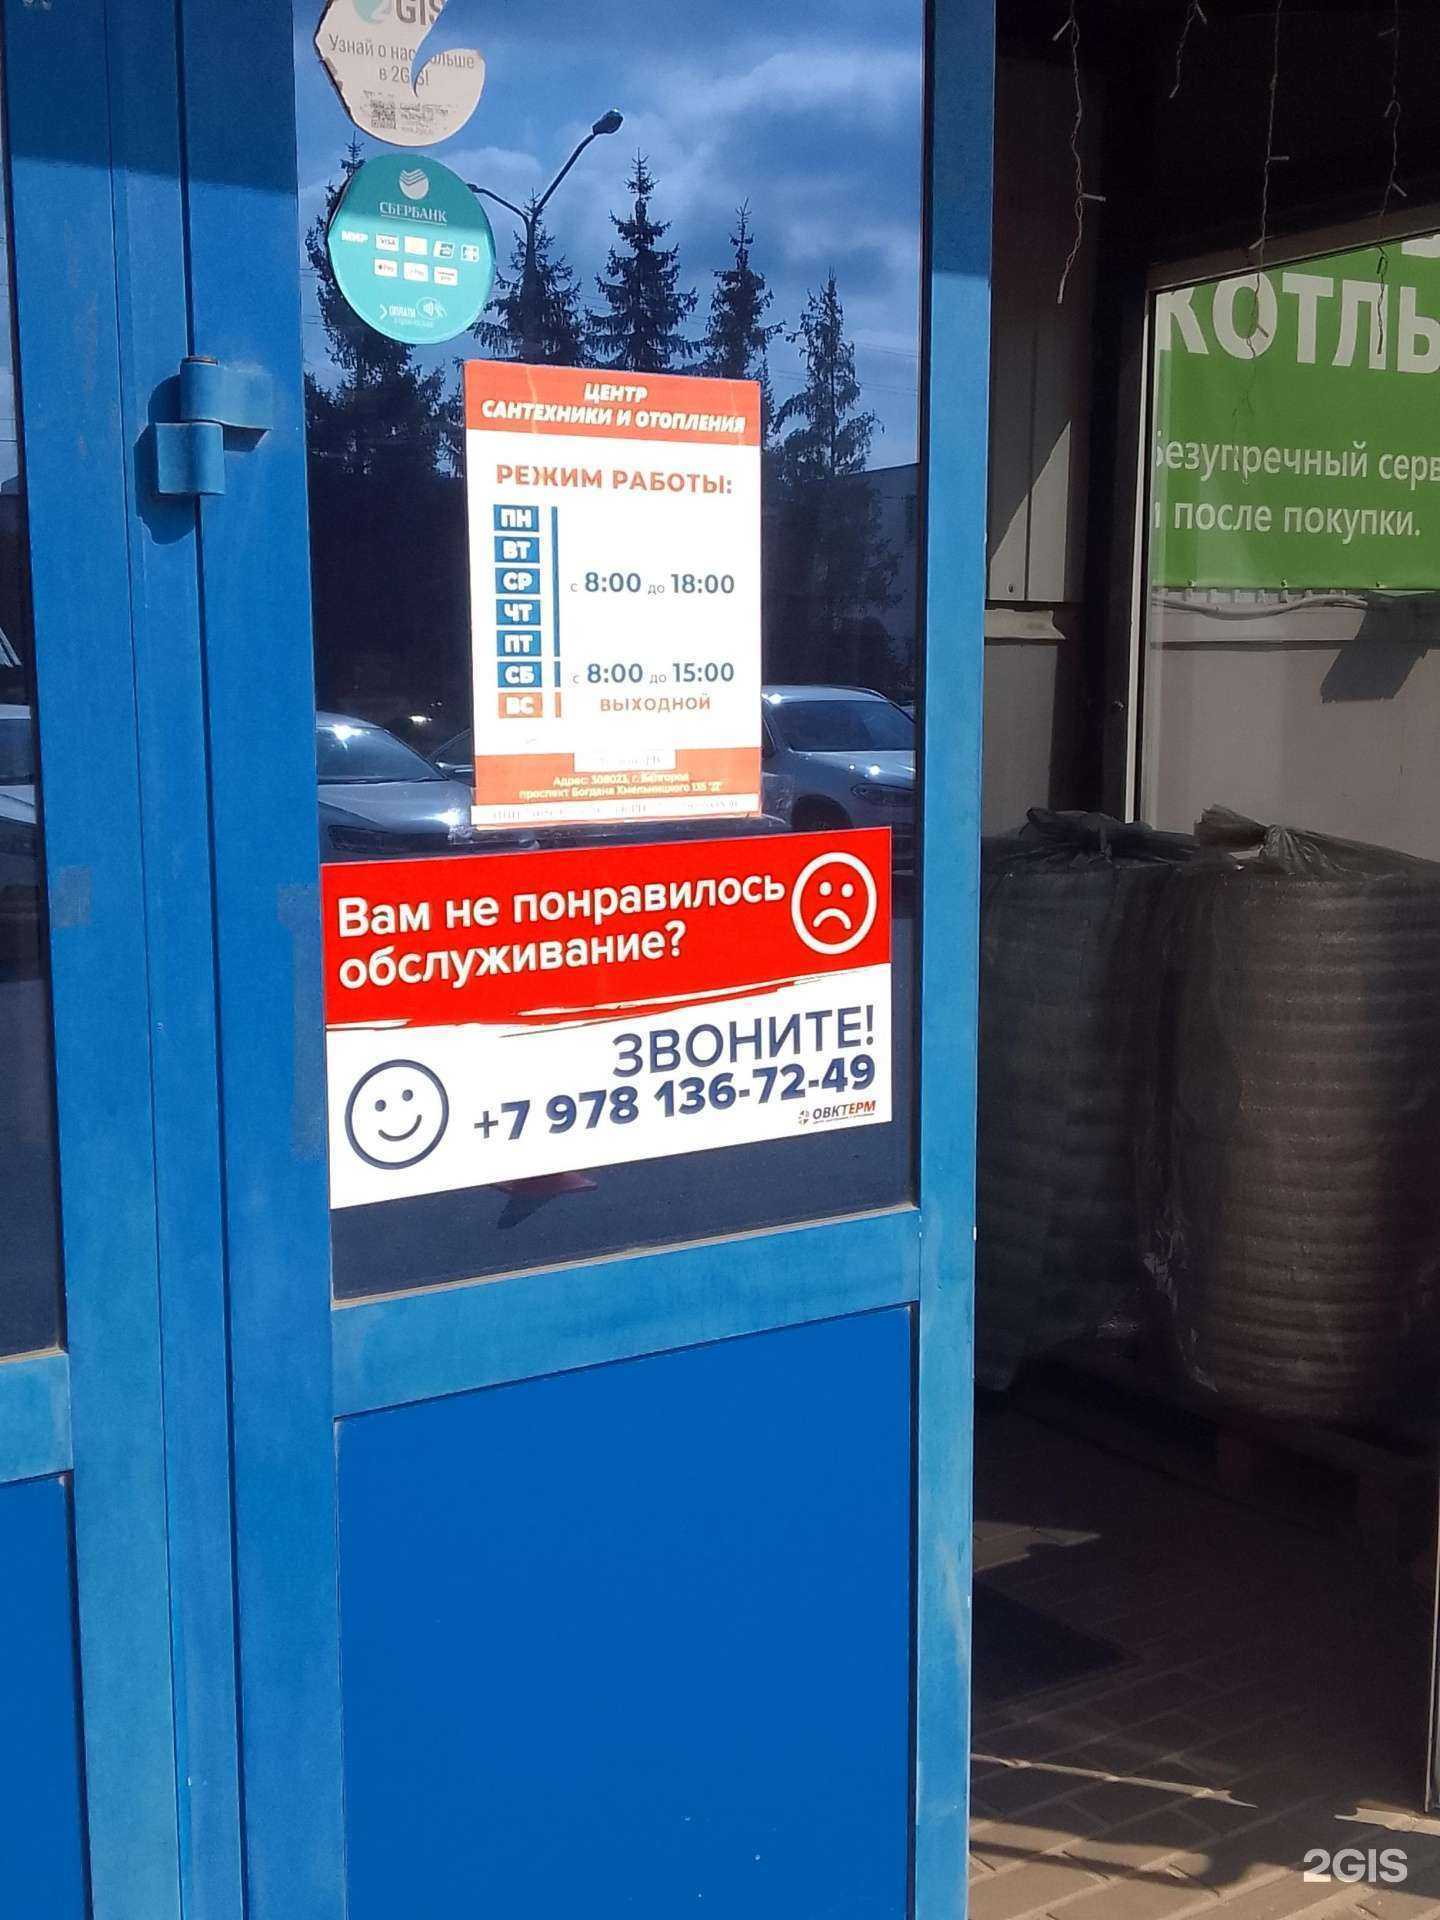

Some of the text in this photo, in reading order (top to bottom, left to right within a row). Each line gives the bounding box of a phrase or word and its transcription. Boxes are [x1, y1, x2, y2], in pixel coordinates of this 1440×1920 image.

[329, 33, 374, 57] Узнай
[378, 45, 386, 58] о
[391, 45, 416, 61] нас
[379, 65, 429, 87] в 2GS!
[379, 201, 448, 223] СБЕРБАНК
[584, 382, 648, 404] ЦЕНТР
[481, 400, 746, 434] САНТЕХНИКИ И ОТОПЛЕНИЯ
[496, 464, 732, 494] РЕЖИМ РАБОТЫ:
[501, 509, 532, 529] ПН
[1174, 502, 1272, 532] после
[1283, 506, 1421, 545] покупки.
[502, 541, 531, 560] ВТ
[502, 573, 533, 591] СР
[585, 573, 641, 593] 8:00
[648, 583, 665, 595] до
[671, 574, 735, 594] 18:00
[503, 604, 533, 622] ЧТ
[504, 634, 533, 653] ПТ
[505, 666, 535, 684] СБ
[587, 663, 643, 684] 8:00
[650, 671, 667, 684] до
[672, 662, 734, 683] 15:00
[505, 696, 535, 715] ВС
[339, 871, 785, 937] Вам не понравилось
[339, 921, 687, 989] обслуживание?
[612, 1003, 875, 1078] ЗВОНИТЕ!
[473, 1054, 876, 1141] +7 978 136-72-49
[812, 1100, 877, 1120] ОВКТЕРМ
